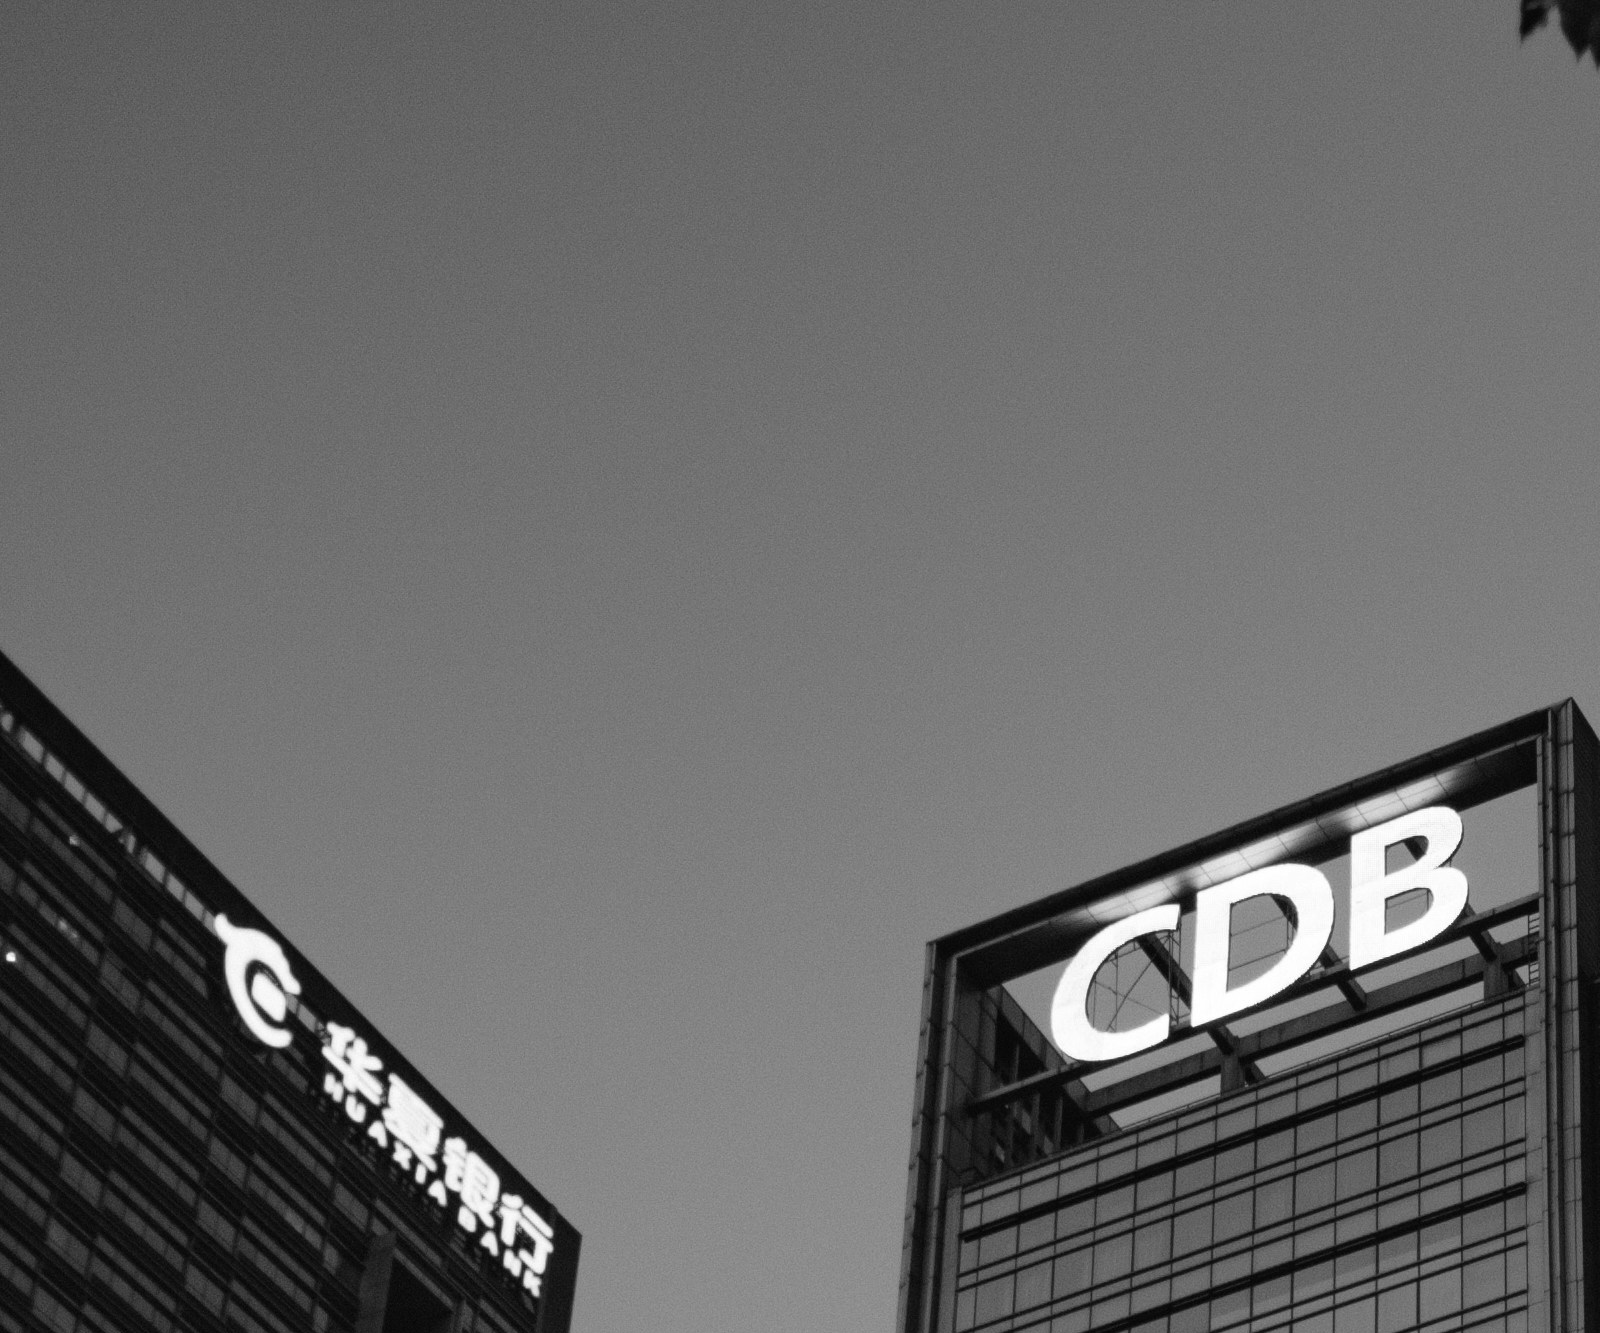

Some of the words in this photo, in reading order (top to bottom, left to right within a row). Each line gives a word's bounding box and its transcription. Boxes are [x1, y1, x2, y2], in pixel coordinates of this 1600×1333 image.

[1051, 806, 1468, 1061] CDB
[322, 1021, 553, 1274] 华夏银行
[323, 1073, 447, 1207] HUAXIA
[457, 1205, 541, 1297] BANK
